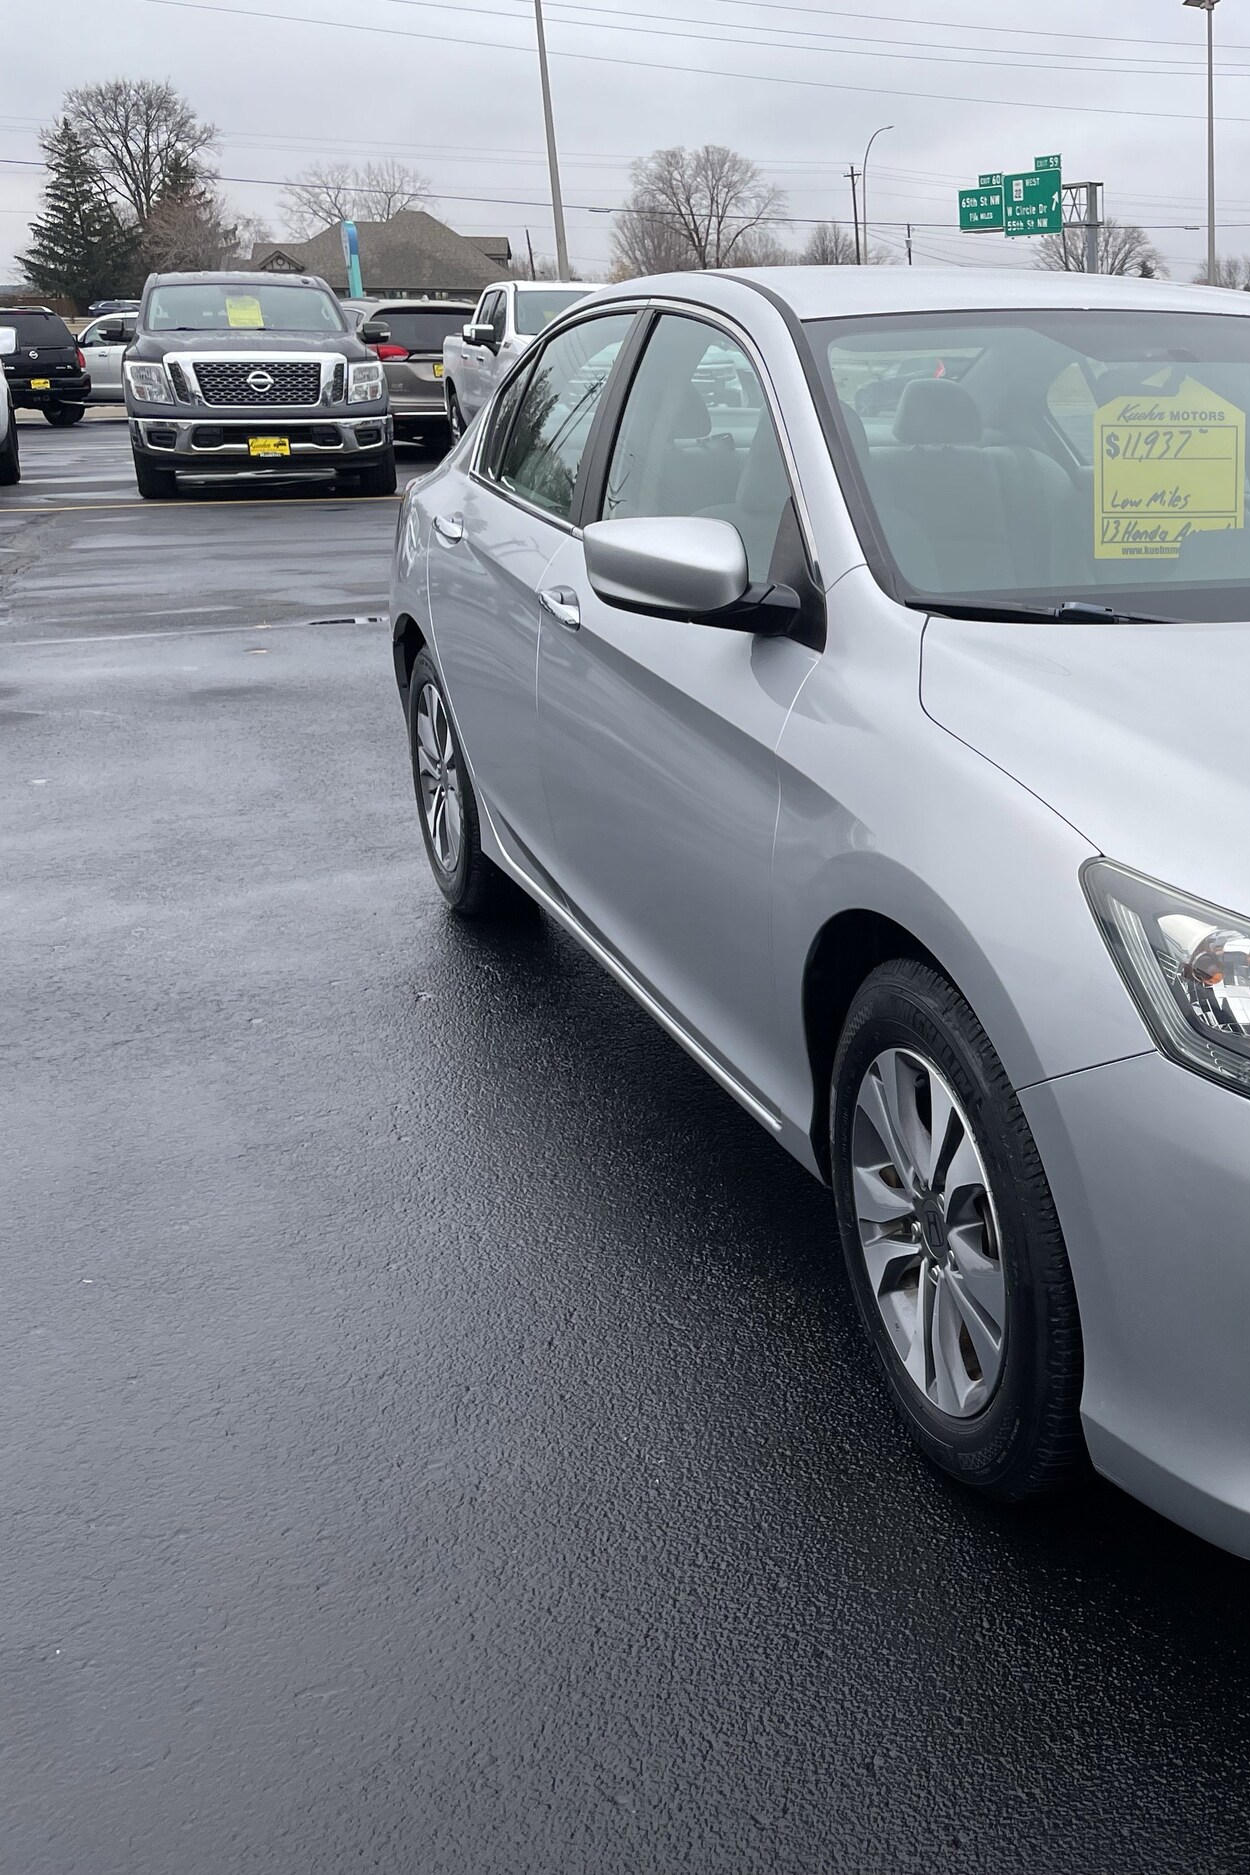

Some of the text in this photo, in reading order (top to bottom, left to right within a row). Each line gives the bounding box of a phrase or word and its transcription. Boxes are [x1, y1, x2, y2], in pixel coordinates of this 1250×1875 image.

[1049, 157, 1059, 167] 59
[991, 175, 1001, 185] 60
[1025, 178, 1040, 187] WEST
[961, 195, 1000, 208] 65th St NW
[1006, 204, 1048, 216] W Circle Dr
[1007, 218, 1048, 231] 55th St NW
[1117, 403, 1225, 423] Kuehn MOTORS
[1111, 485, 1191, 510] Low Miles
[1122, 520, 1169, 542] Honda
